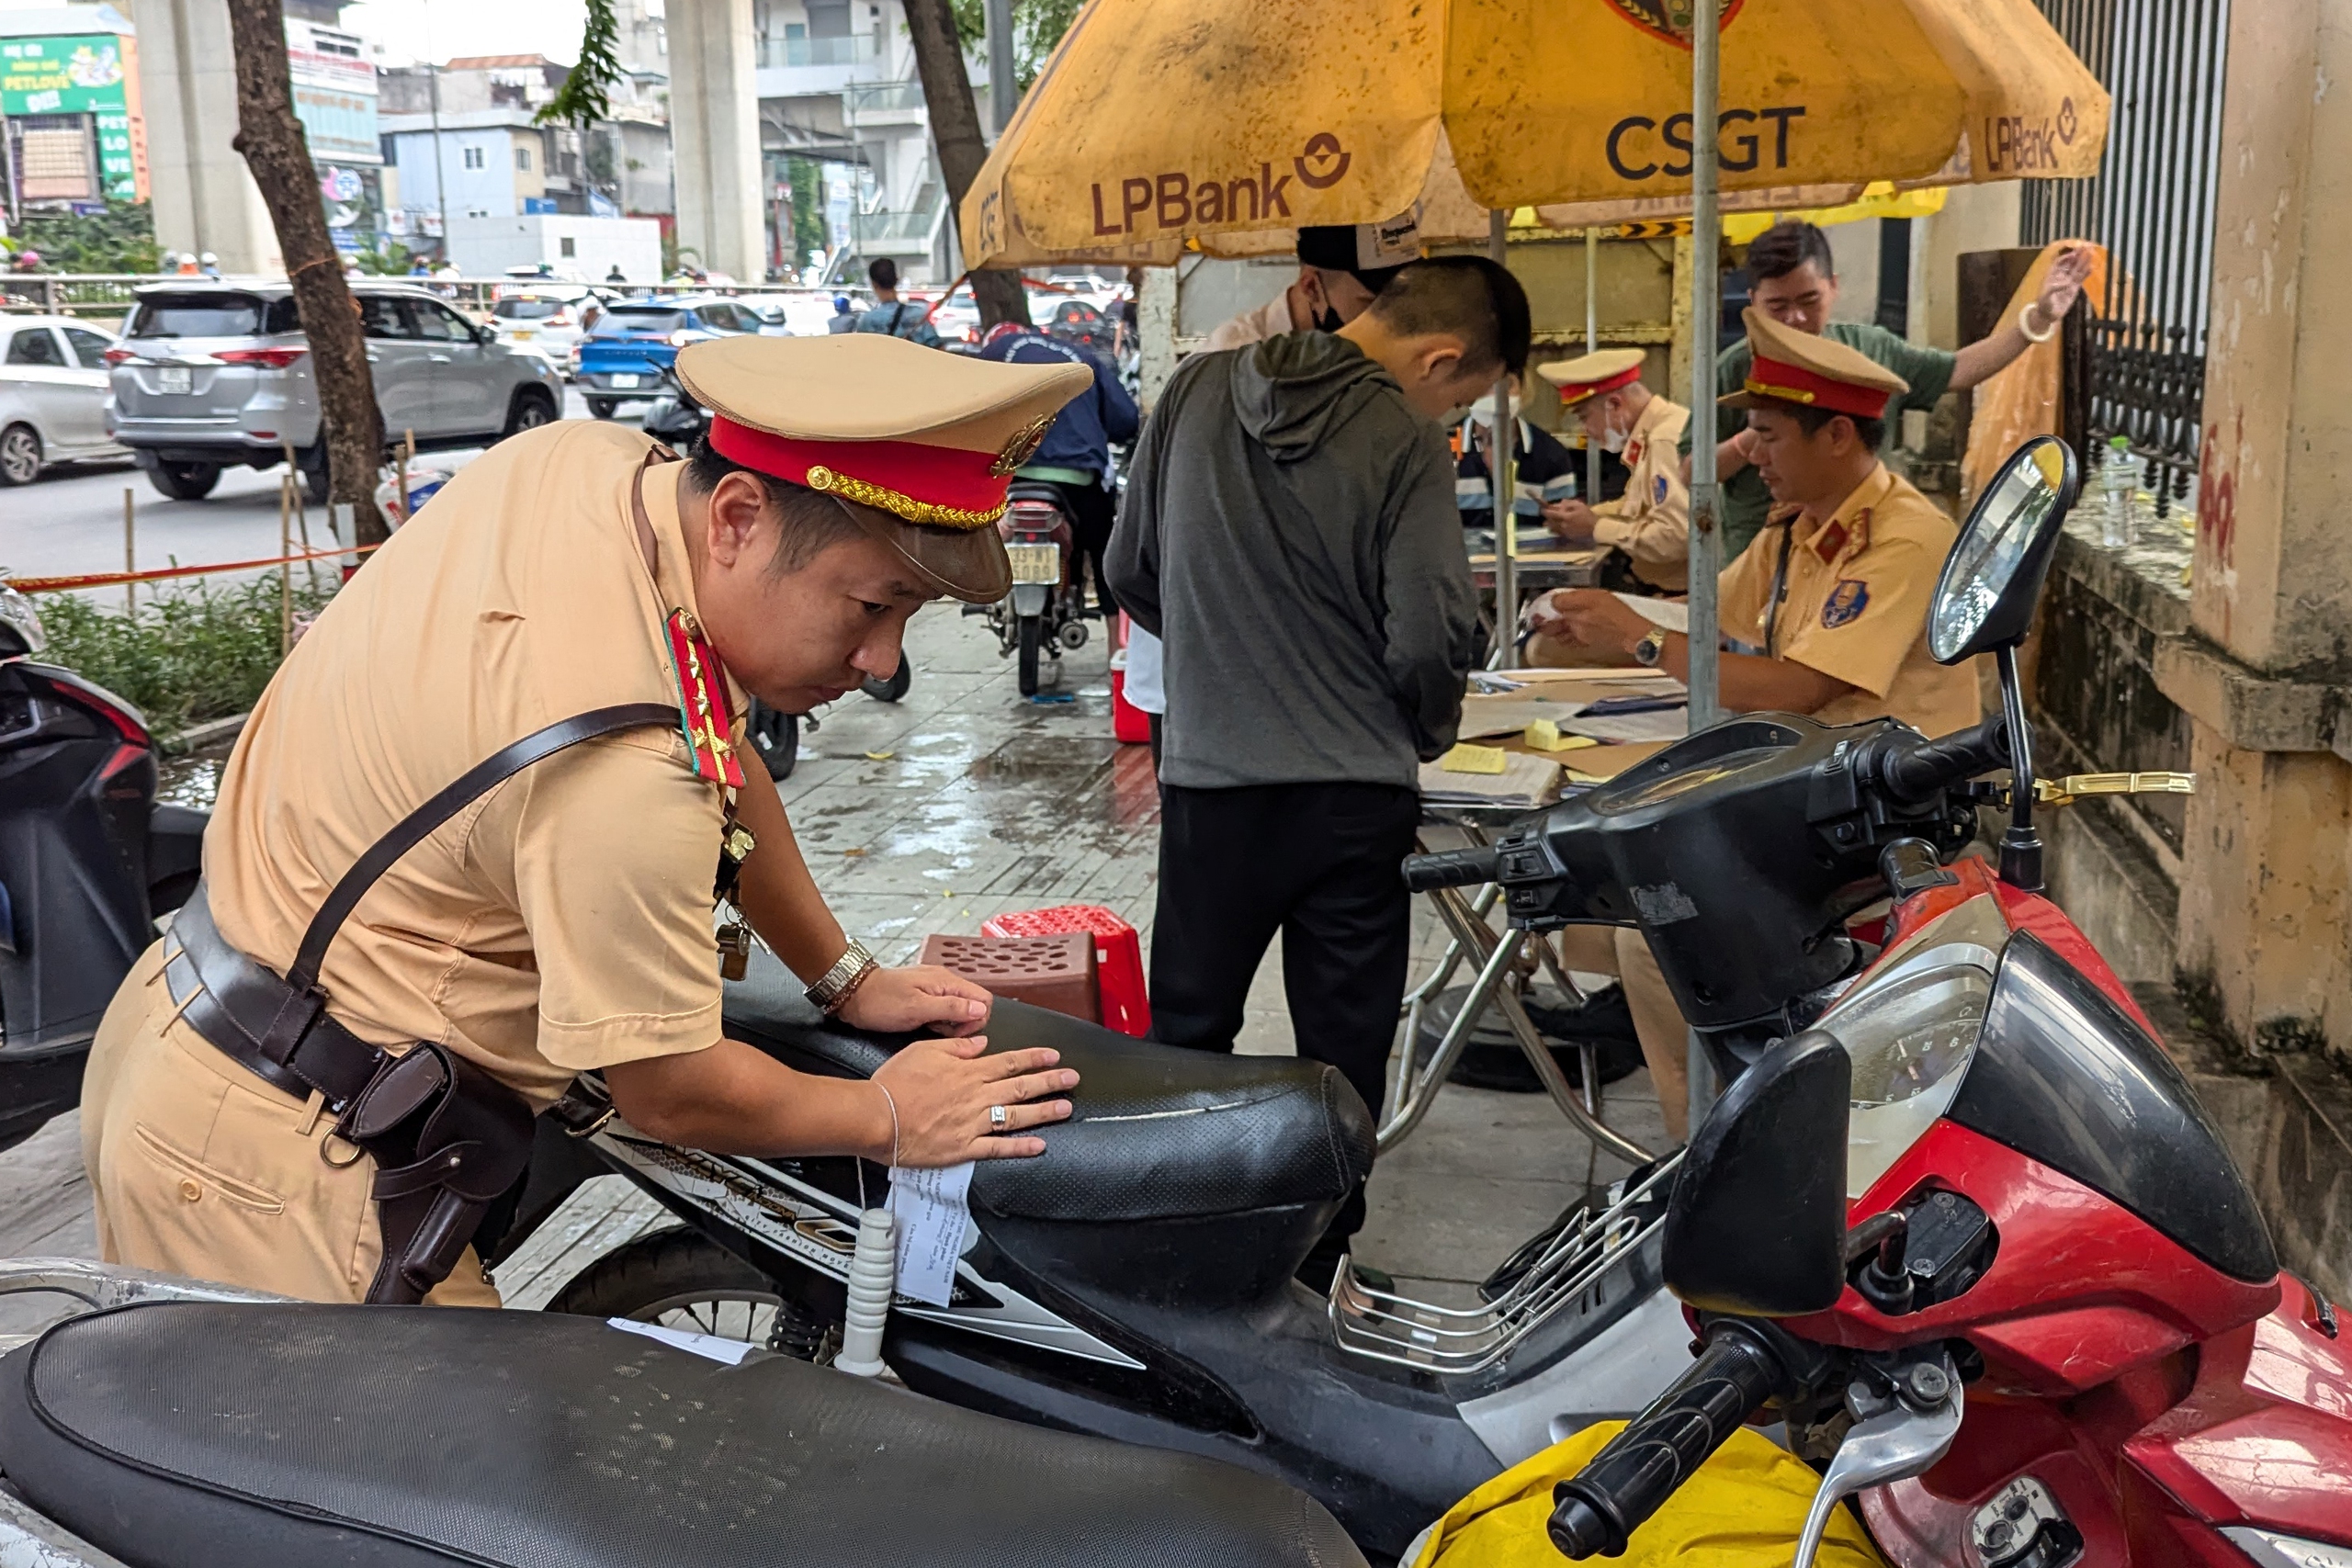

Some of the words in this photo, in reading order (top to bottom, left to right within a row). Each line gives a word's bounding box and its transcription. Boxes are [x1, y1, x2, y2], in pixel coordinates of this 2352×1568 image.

[97, 116, 128, 130] PET
[1606, 107, 1805, 180] CSGT
[1984, 117, 2058, 173] LPBank
[1091, 163, 1293, 237] LPBank
[744, 1214, 768, 1229] CITY
[773, 1228, 817, 1254] FASHION
